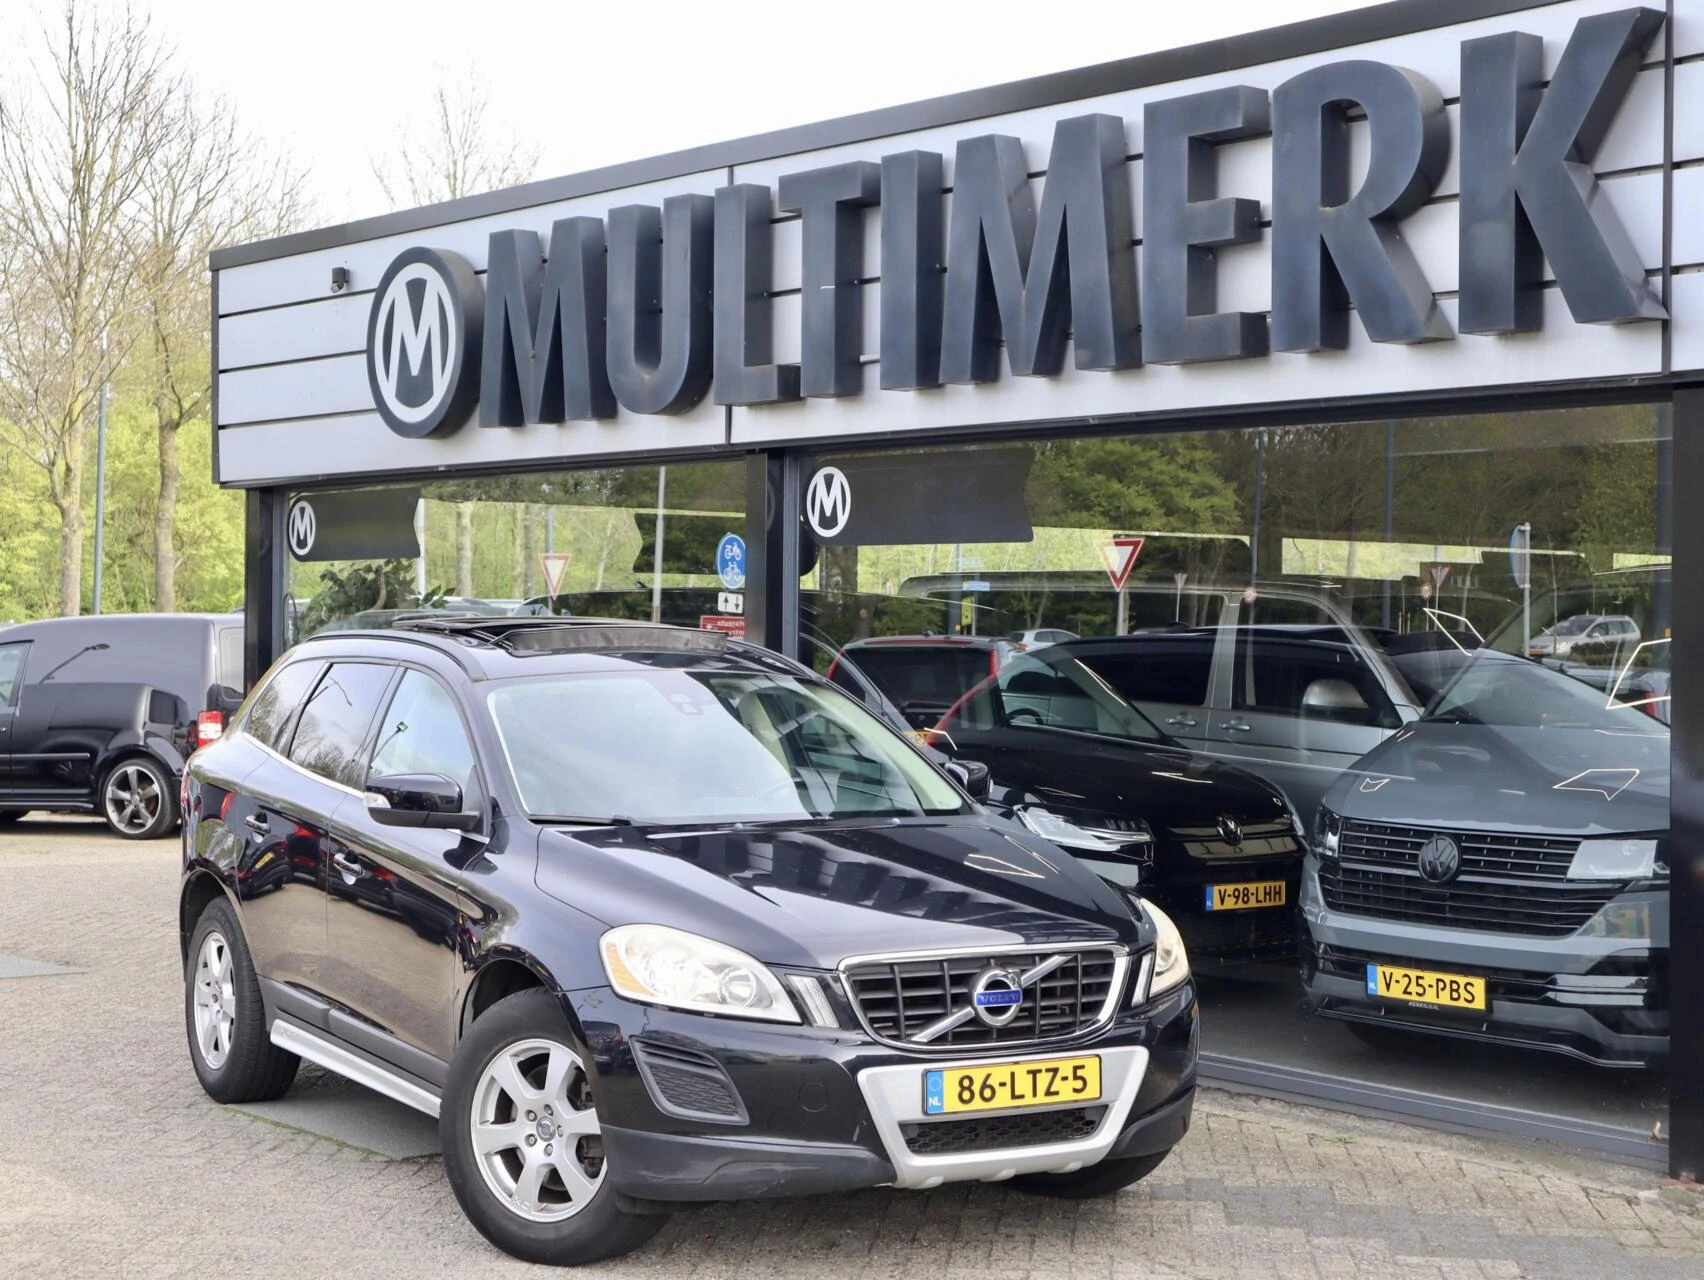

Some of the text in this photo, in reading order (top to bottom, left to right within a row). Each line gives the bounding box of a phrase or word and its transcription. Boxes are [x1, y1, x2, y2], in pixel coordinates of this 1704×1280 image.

[479, 7, 1669, 429] MULTIMERK
[378, 264, 455, 421] M
[807, 467, 850, 536] M
[290, 502, 315, 554] M
[1218, 884, 1282, 906] V-98-LHH
[1382, 970, 1476, 1004] V-25-PBS
[928, 1096, 942, 1107] NL
[957, 1064, 1088, 1105] 86-LTZ-5
